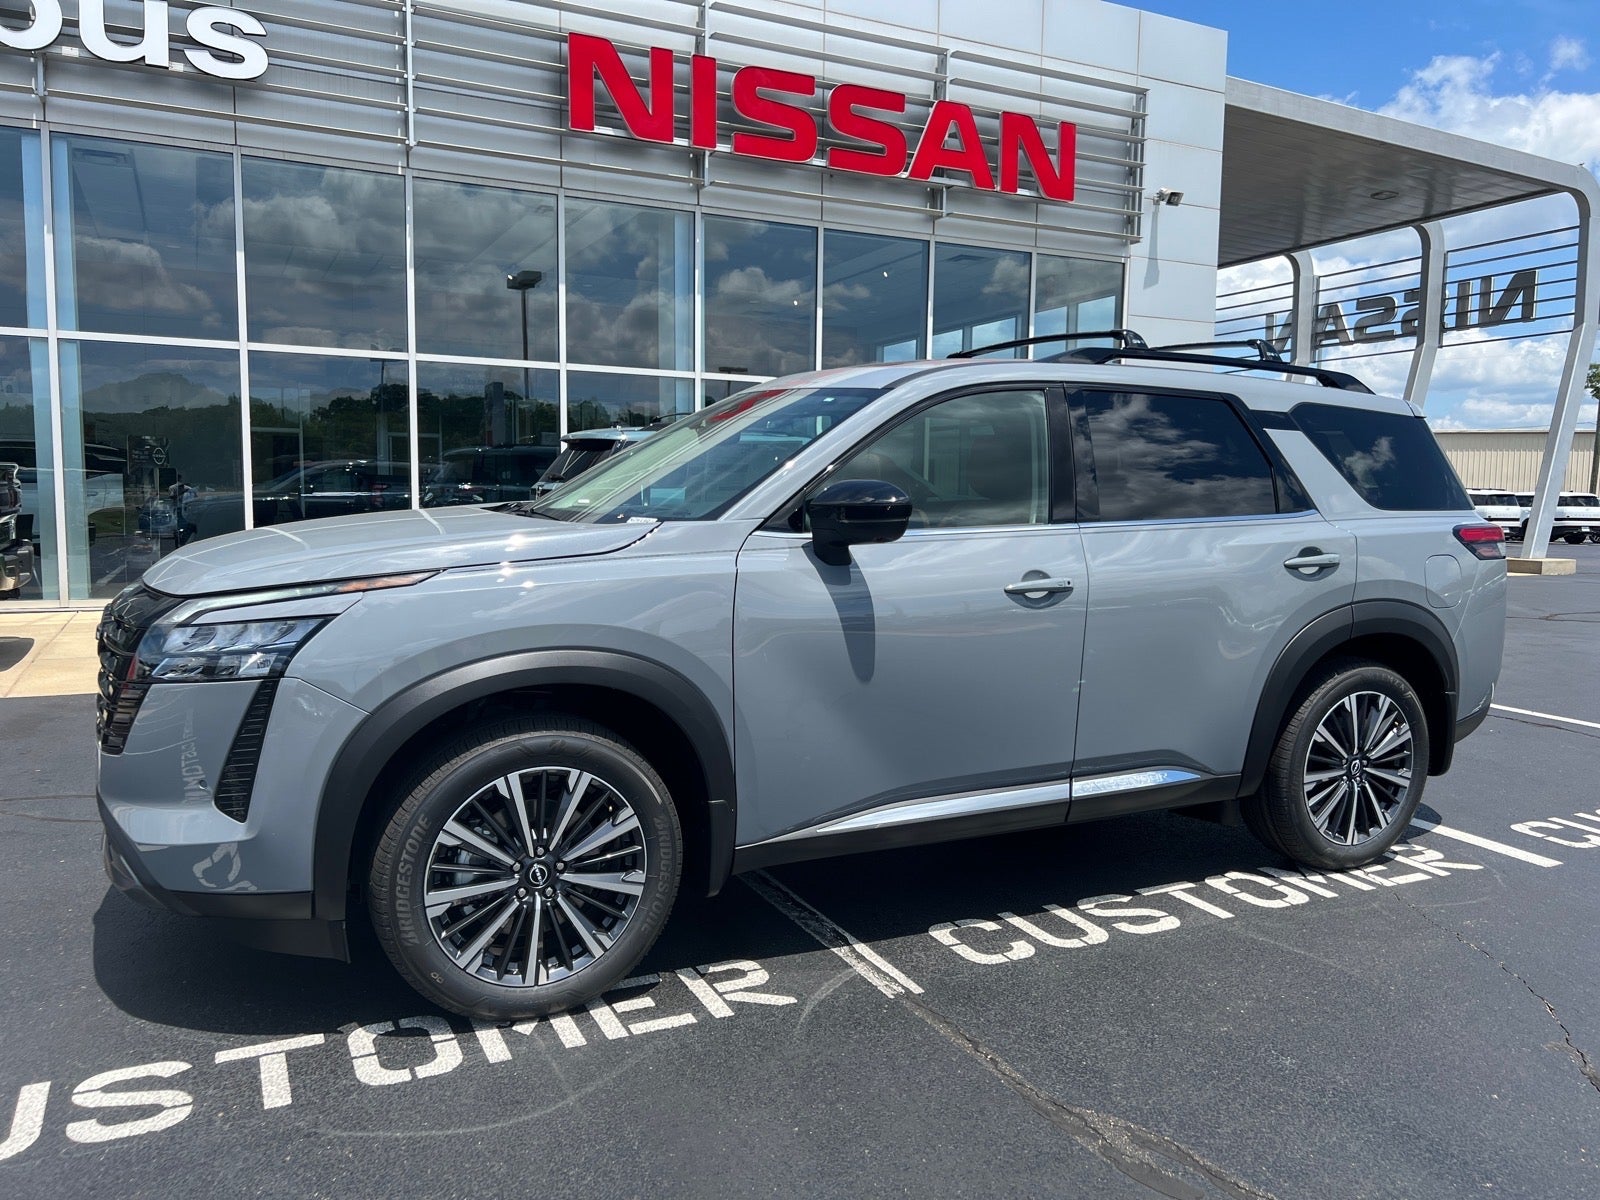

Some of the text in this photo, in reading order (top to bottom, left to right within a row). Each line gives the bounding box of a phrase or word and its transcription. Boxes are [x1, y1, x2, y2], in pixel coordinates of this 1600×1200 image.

[568, 32, 1076, 202] NISSAN
[395, 812, 432, 947] BRIDGESTONE
[928, 843, 1484, 965] CUSTOMER
